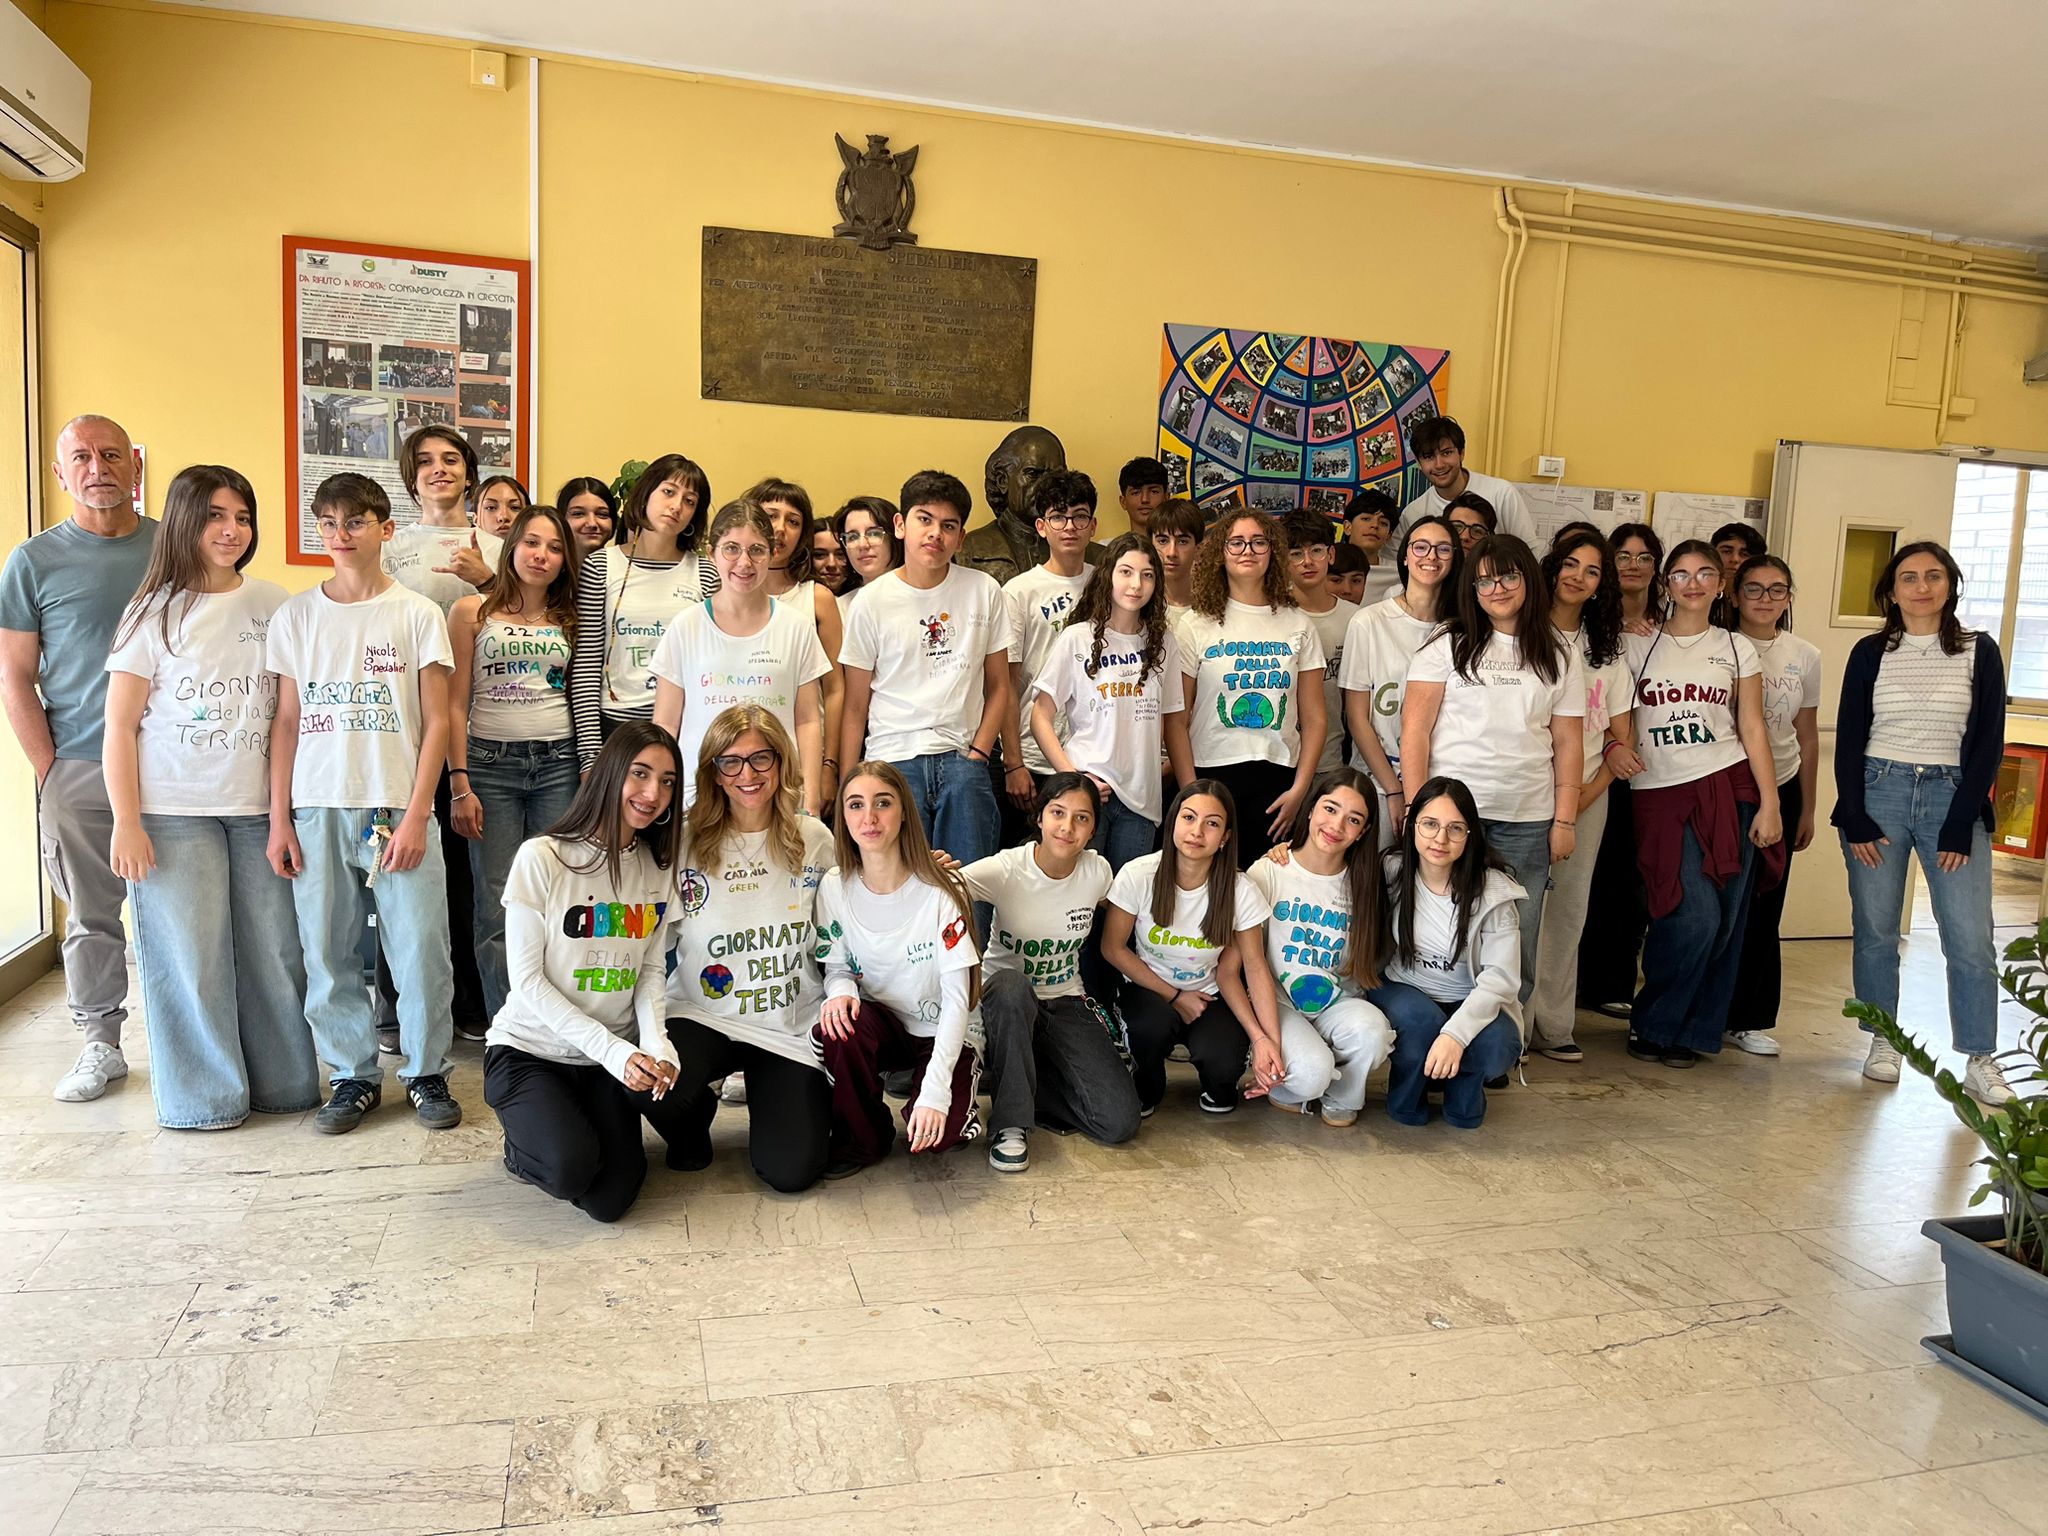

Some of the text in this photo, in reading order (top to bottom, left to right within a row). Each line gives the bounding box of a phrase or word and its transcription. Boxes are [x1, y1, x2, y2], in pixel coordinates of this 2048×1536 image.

[804, 243, 863, 262] NICOLA
[888, 251, 977, 272] SPEDALIERI
[299, 273, 310, 283] DA
[417, 268, 448, 278] DUSTY
[504, 626, 534, 638] 22
[366, 642, 398, 658] Nicola
[482, 660, 542, 677] TERRA
[1234, 658, 1281, 672] DELLA
[1223, 671, 1291, 691] TERRA
[1096, 682, 1145, 700] TERRA
[704, 695, 738, 706] DELLA
[207, 701, 261, 721] della
[340, 709, 401, 733] TERRA
[176, 724, 262, 751] TERRA
[1647, 722, 1717, 748] TERRA
[724, 867, 769, 881] CATANIA
[728, 882, 760, 894] GREEN
[1290, 926, 1346, 951] DELLA
[586, 950, 632, 968] DELLA
[748, 951, 803, 982] DELLA
[1024, 954, 1075, 976] DELLA
[573, 967, 638, 993] TERRA
